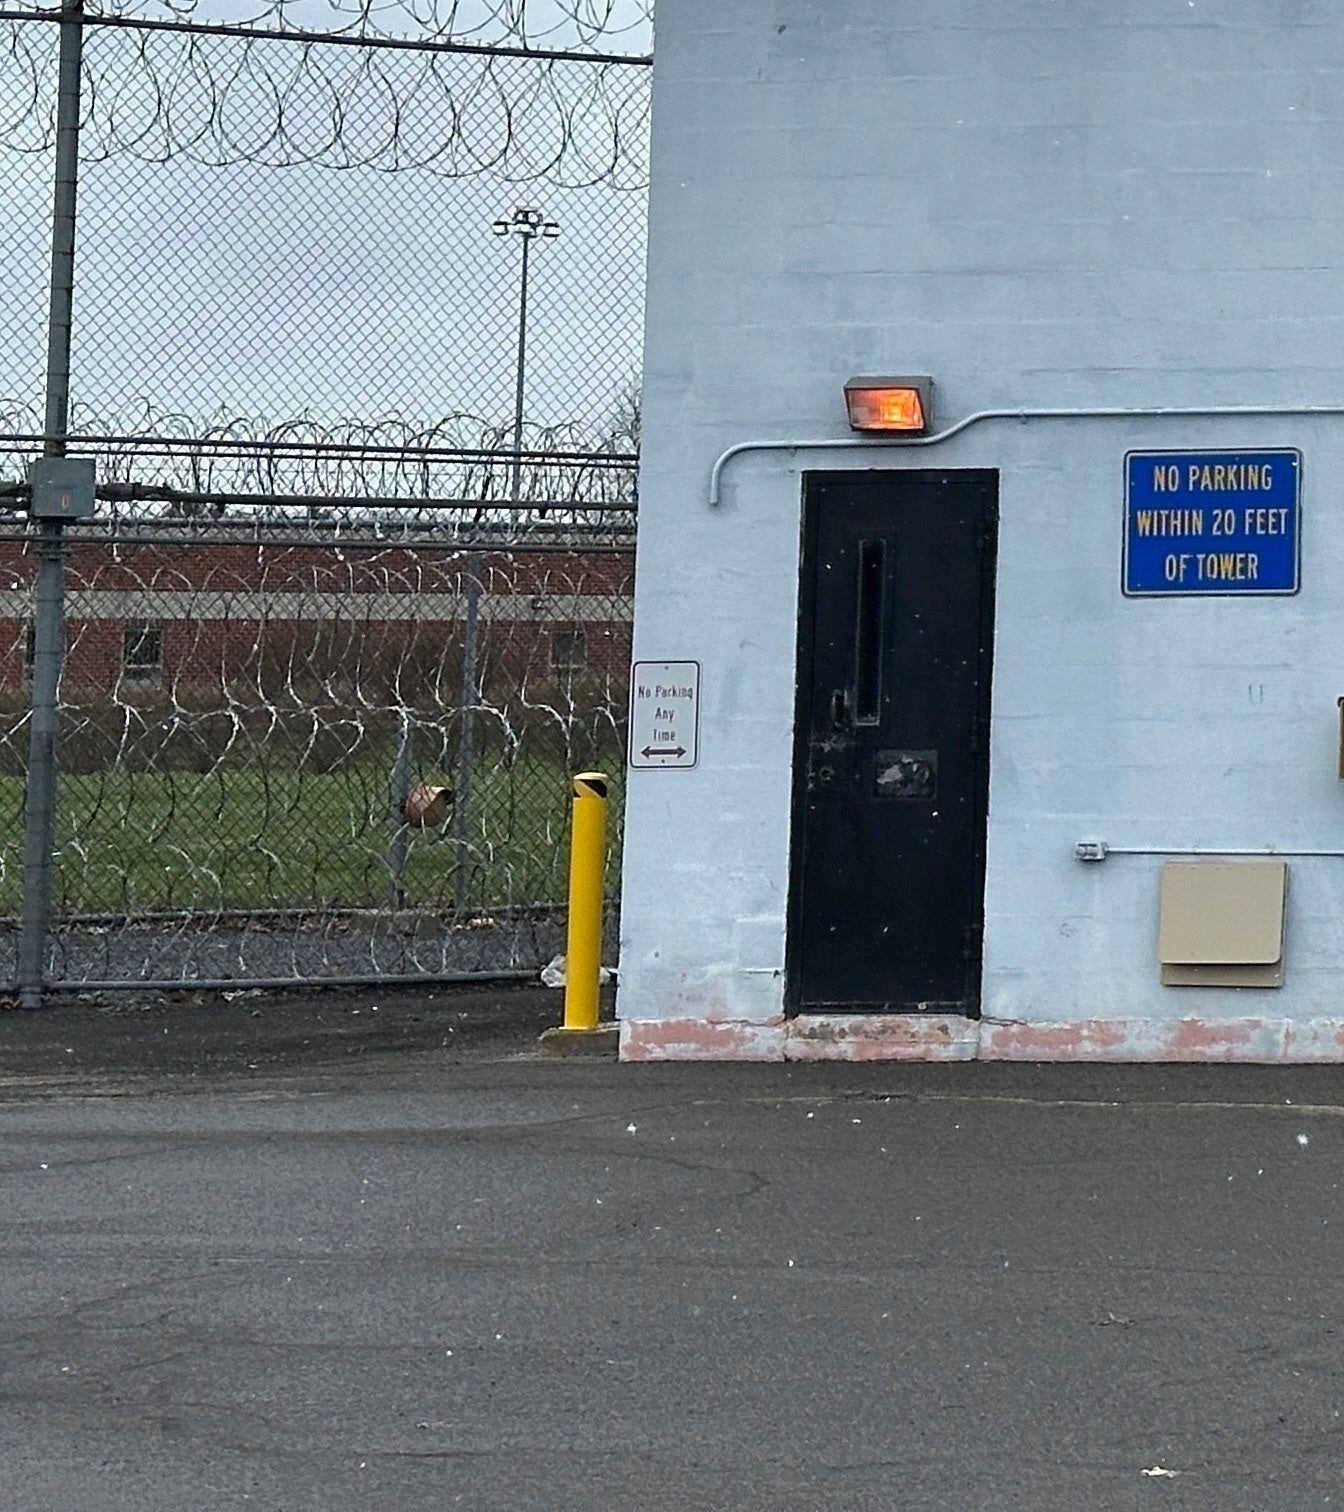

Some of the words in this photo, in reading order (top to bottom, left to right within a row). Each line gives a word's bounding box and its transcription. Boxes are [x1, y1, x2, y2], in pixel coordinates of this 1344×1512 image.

[1154, 464, 1179, 492] NO
[1188, 464, 1272, 491] PARKING
[1136, 509, 1203, 537] WITHIN
[1212, 509, 1236, 535] 20
[1245, 508, 1289, 535] FEET
[1165, 553, 1192, 582] OF
[1196, 553, 1258, 580] TOWER
[638, 685, 651, 699] No
[655, 685, 694, 701] Parking
[655, 707, 675, 723] Any
[653, 729, 676, 742] Time
